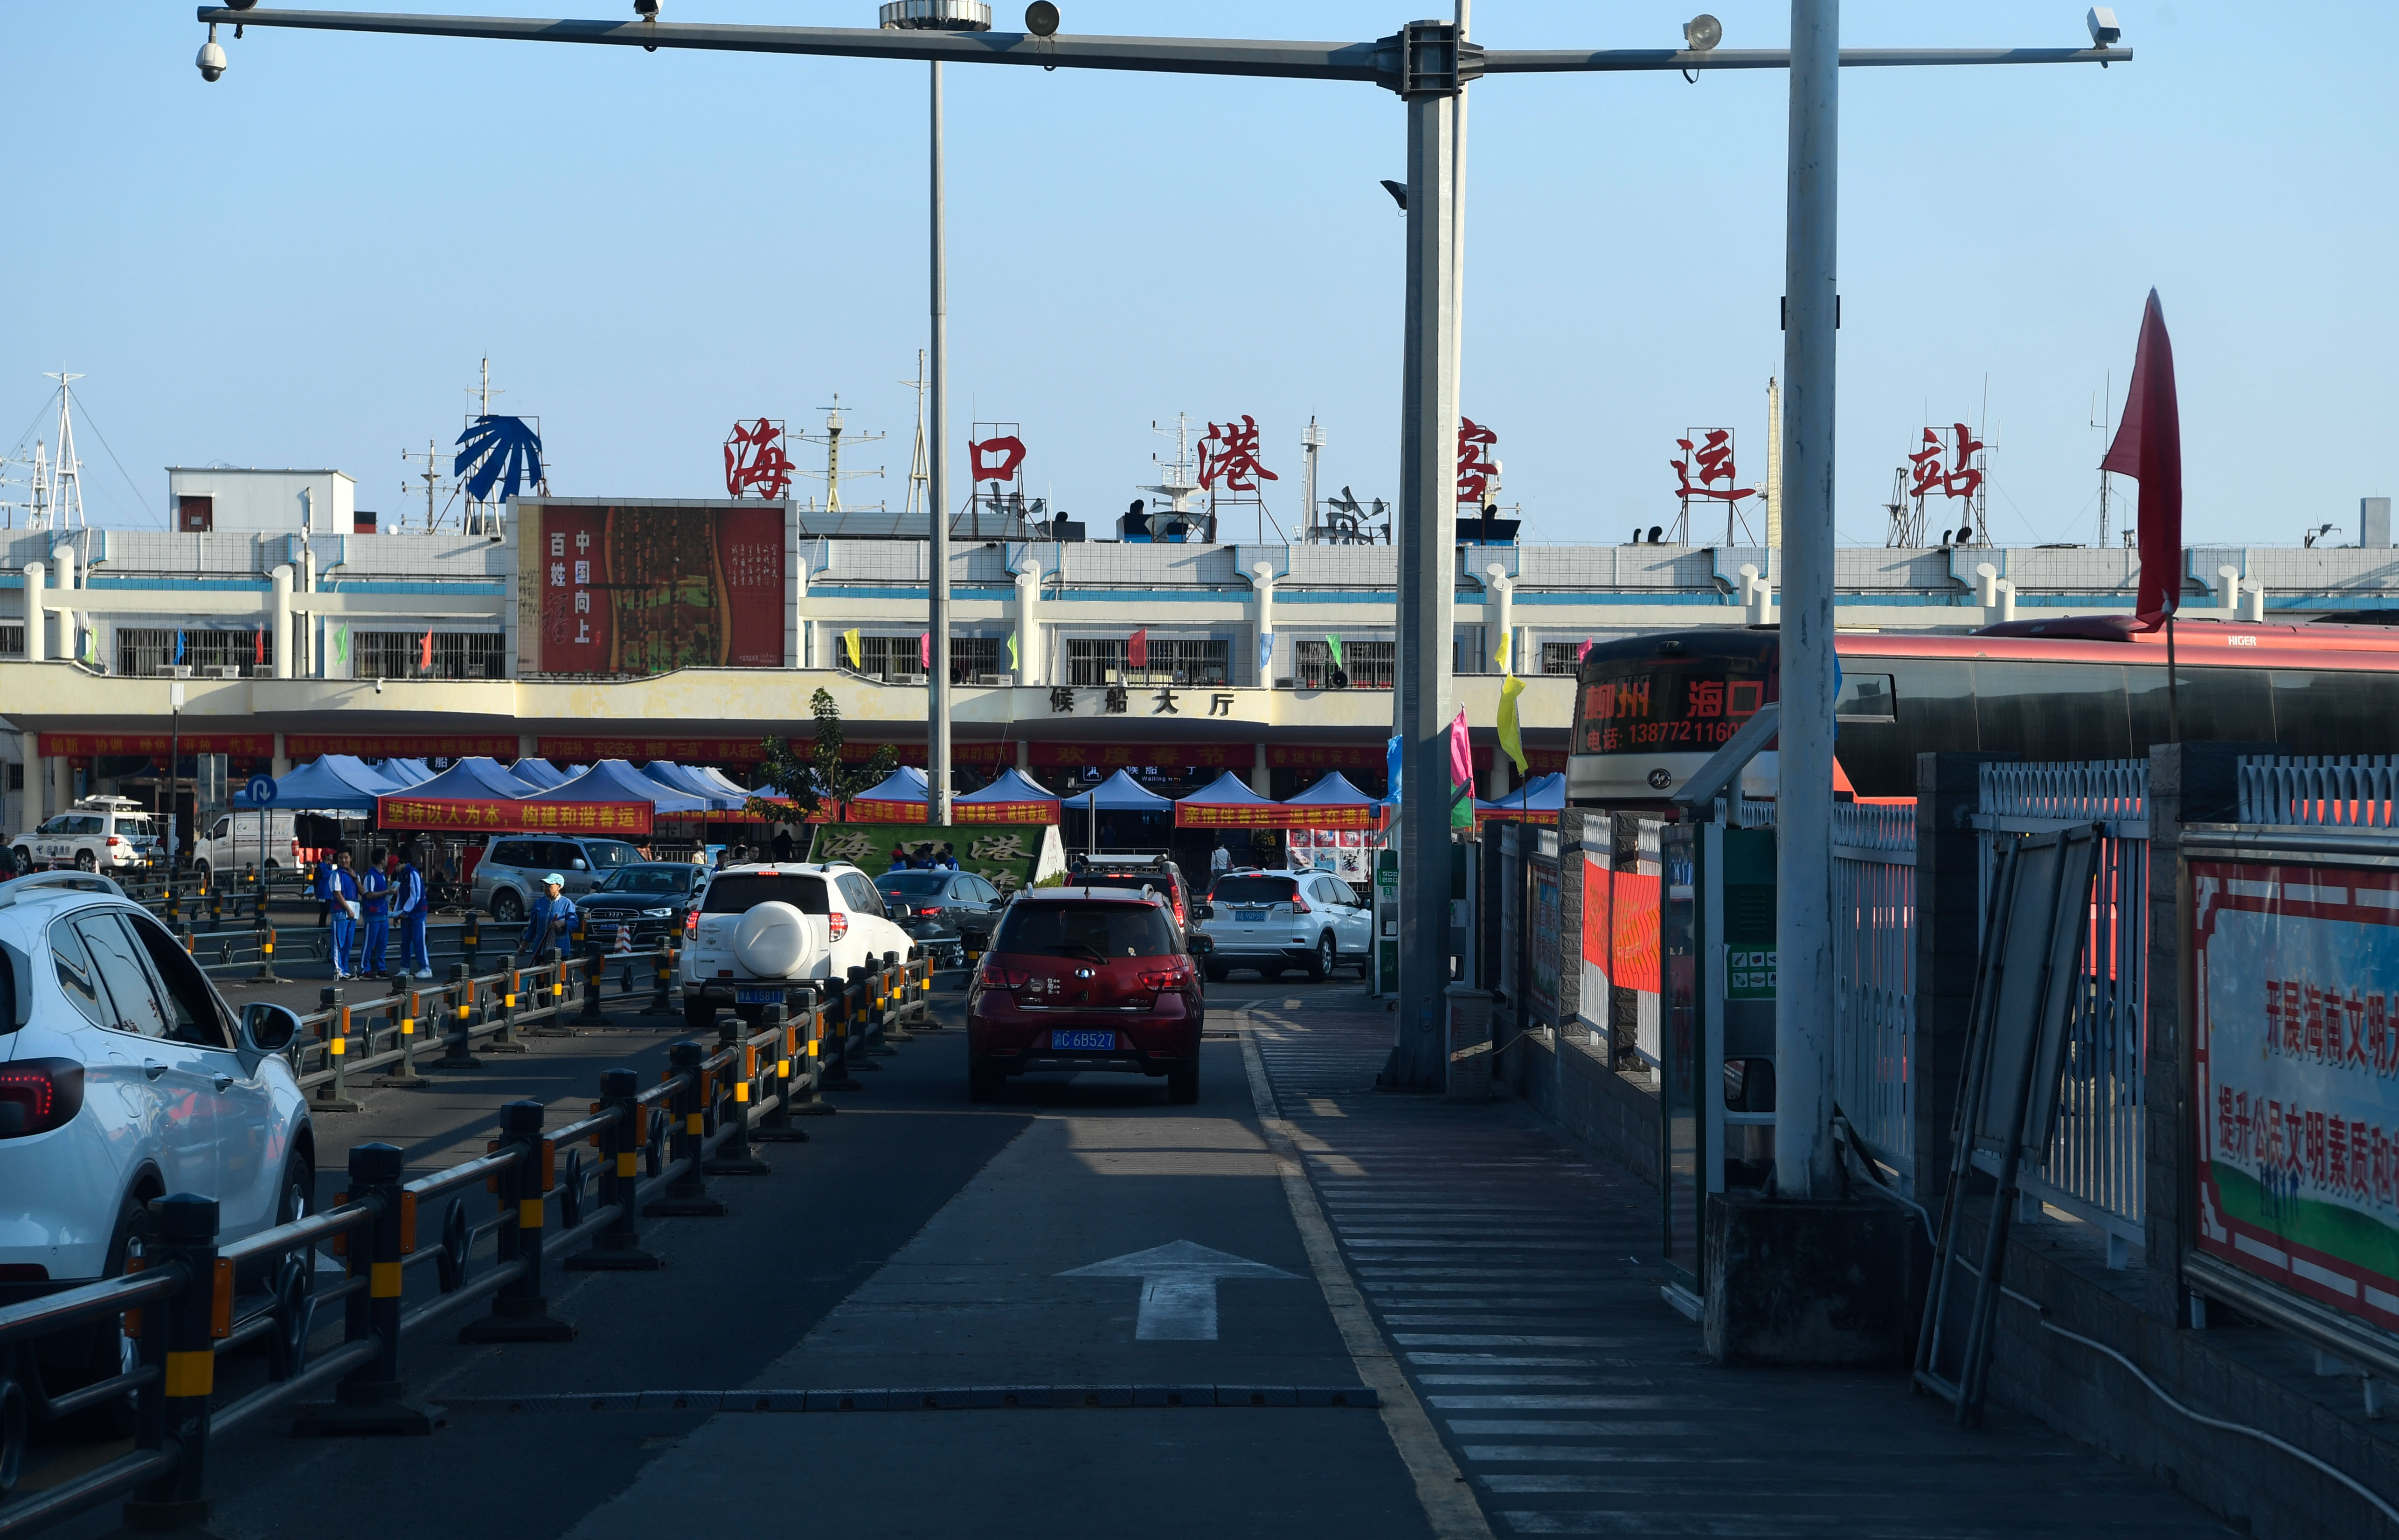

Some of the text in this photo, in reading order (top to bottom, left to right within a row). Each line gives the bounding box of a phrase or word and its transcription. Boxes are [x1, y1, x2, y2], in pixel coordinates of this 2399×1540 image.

[575, 530, 590, 643] 中国向上
[2228, 635, 2257, 646] HIGER
[1050, 688, 1235, 717] 候船大厅
[1585, 681, 1764, 720] 柳州 海口
[1629, 721, 1748, 743] 1387721160
[1056, 746, 1227, 764] 欢度春节
[2218, 1082, 2399, 1209] 提升公民文明素质和
